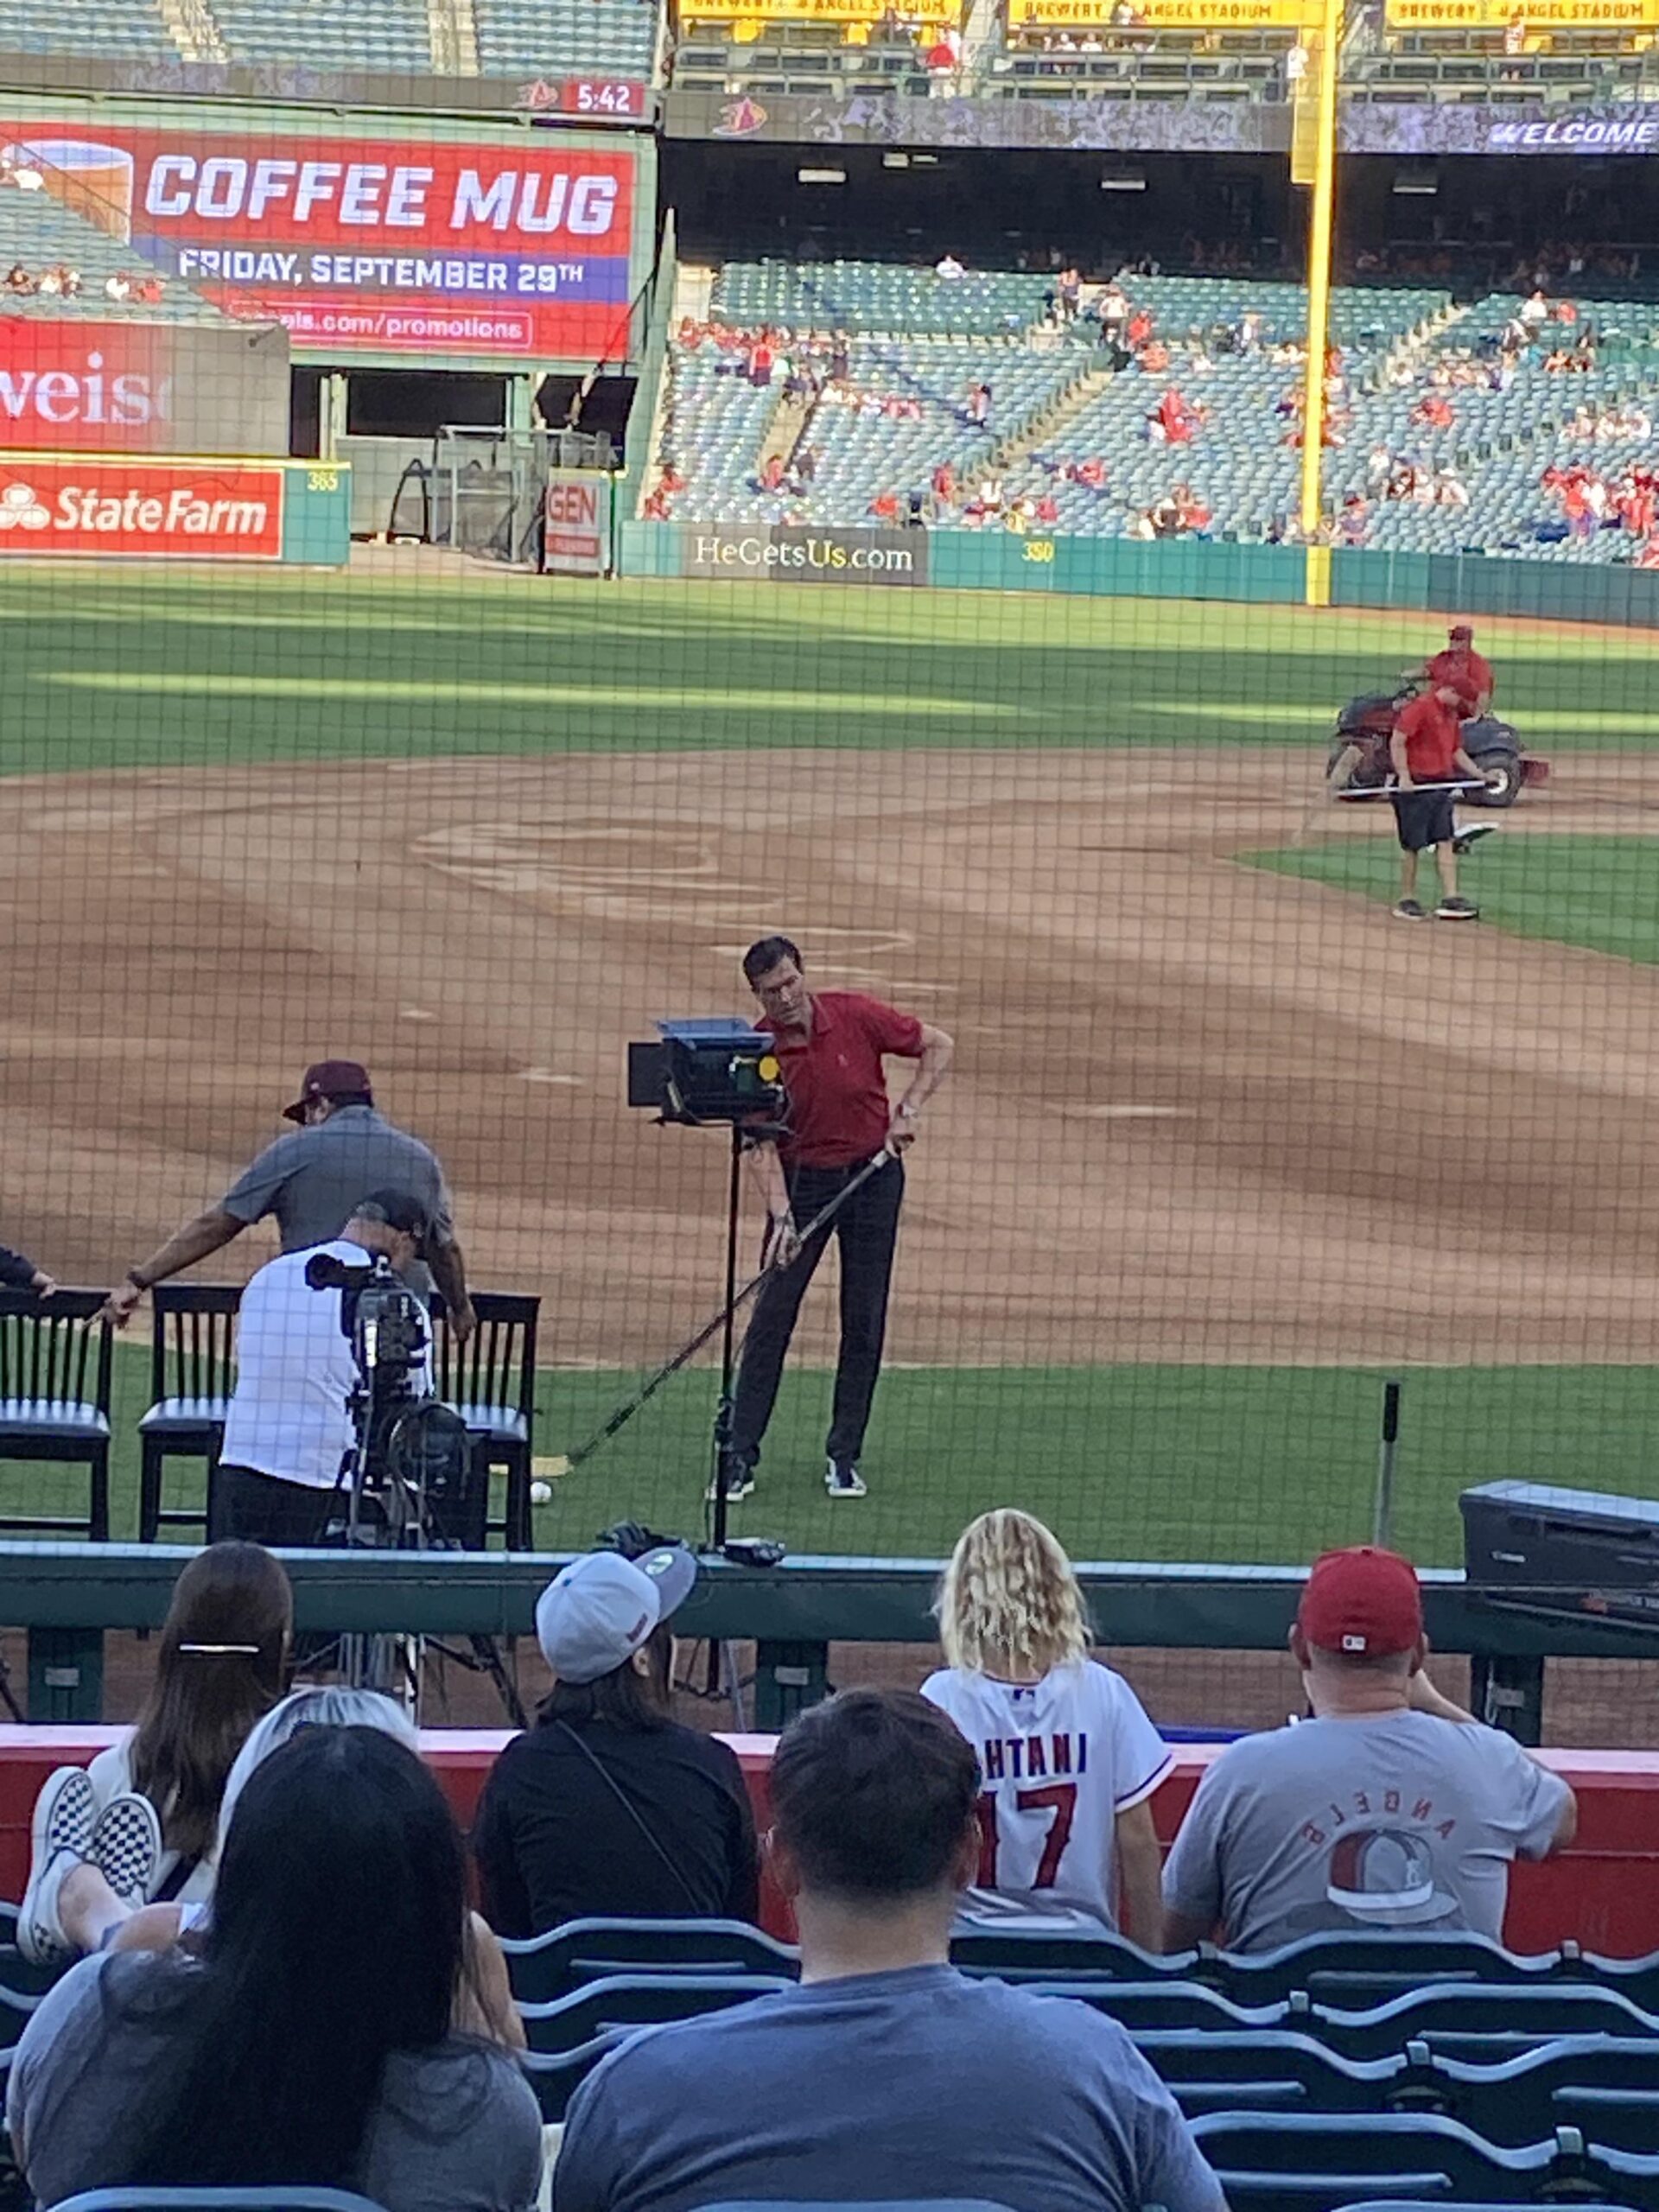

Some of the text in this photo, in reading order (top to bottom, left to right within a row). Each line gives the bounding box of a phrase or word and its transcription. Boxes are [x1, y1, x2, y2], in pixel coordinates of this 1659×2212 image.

[577, 84, 631, 111] 5:42
[1490, 121, 1658, 144] WELCOME
[144, 154, 619, 234] COFFEE MUG
[178, 247, 585, 292] FRIDAY, SEPTEMBER 29TH
[548, 485, 597, 526] GEN
[695, 536, 913, 572] HeGetsUs.com
[982, 1732, 1087, 1780] HTANI
[976, 1782, 1077, 1891] 17
